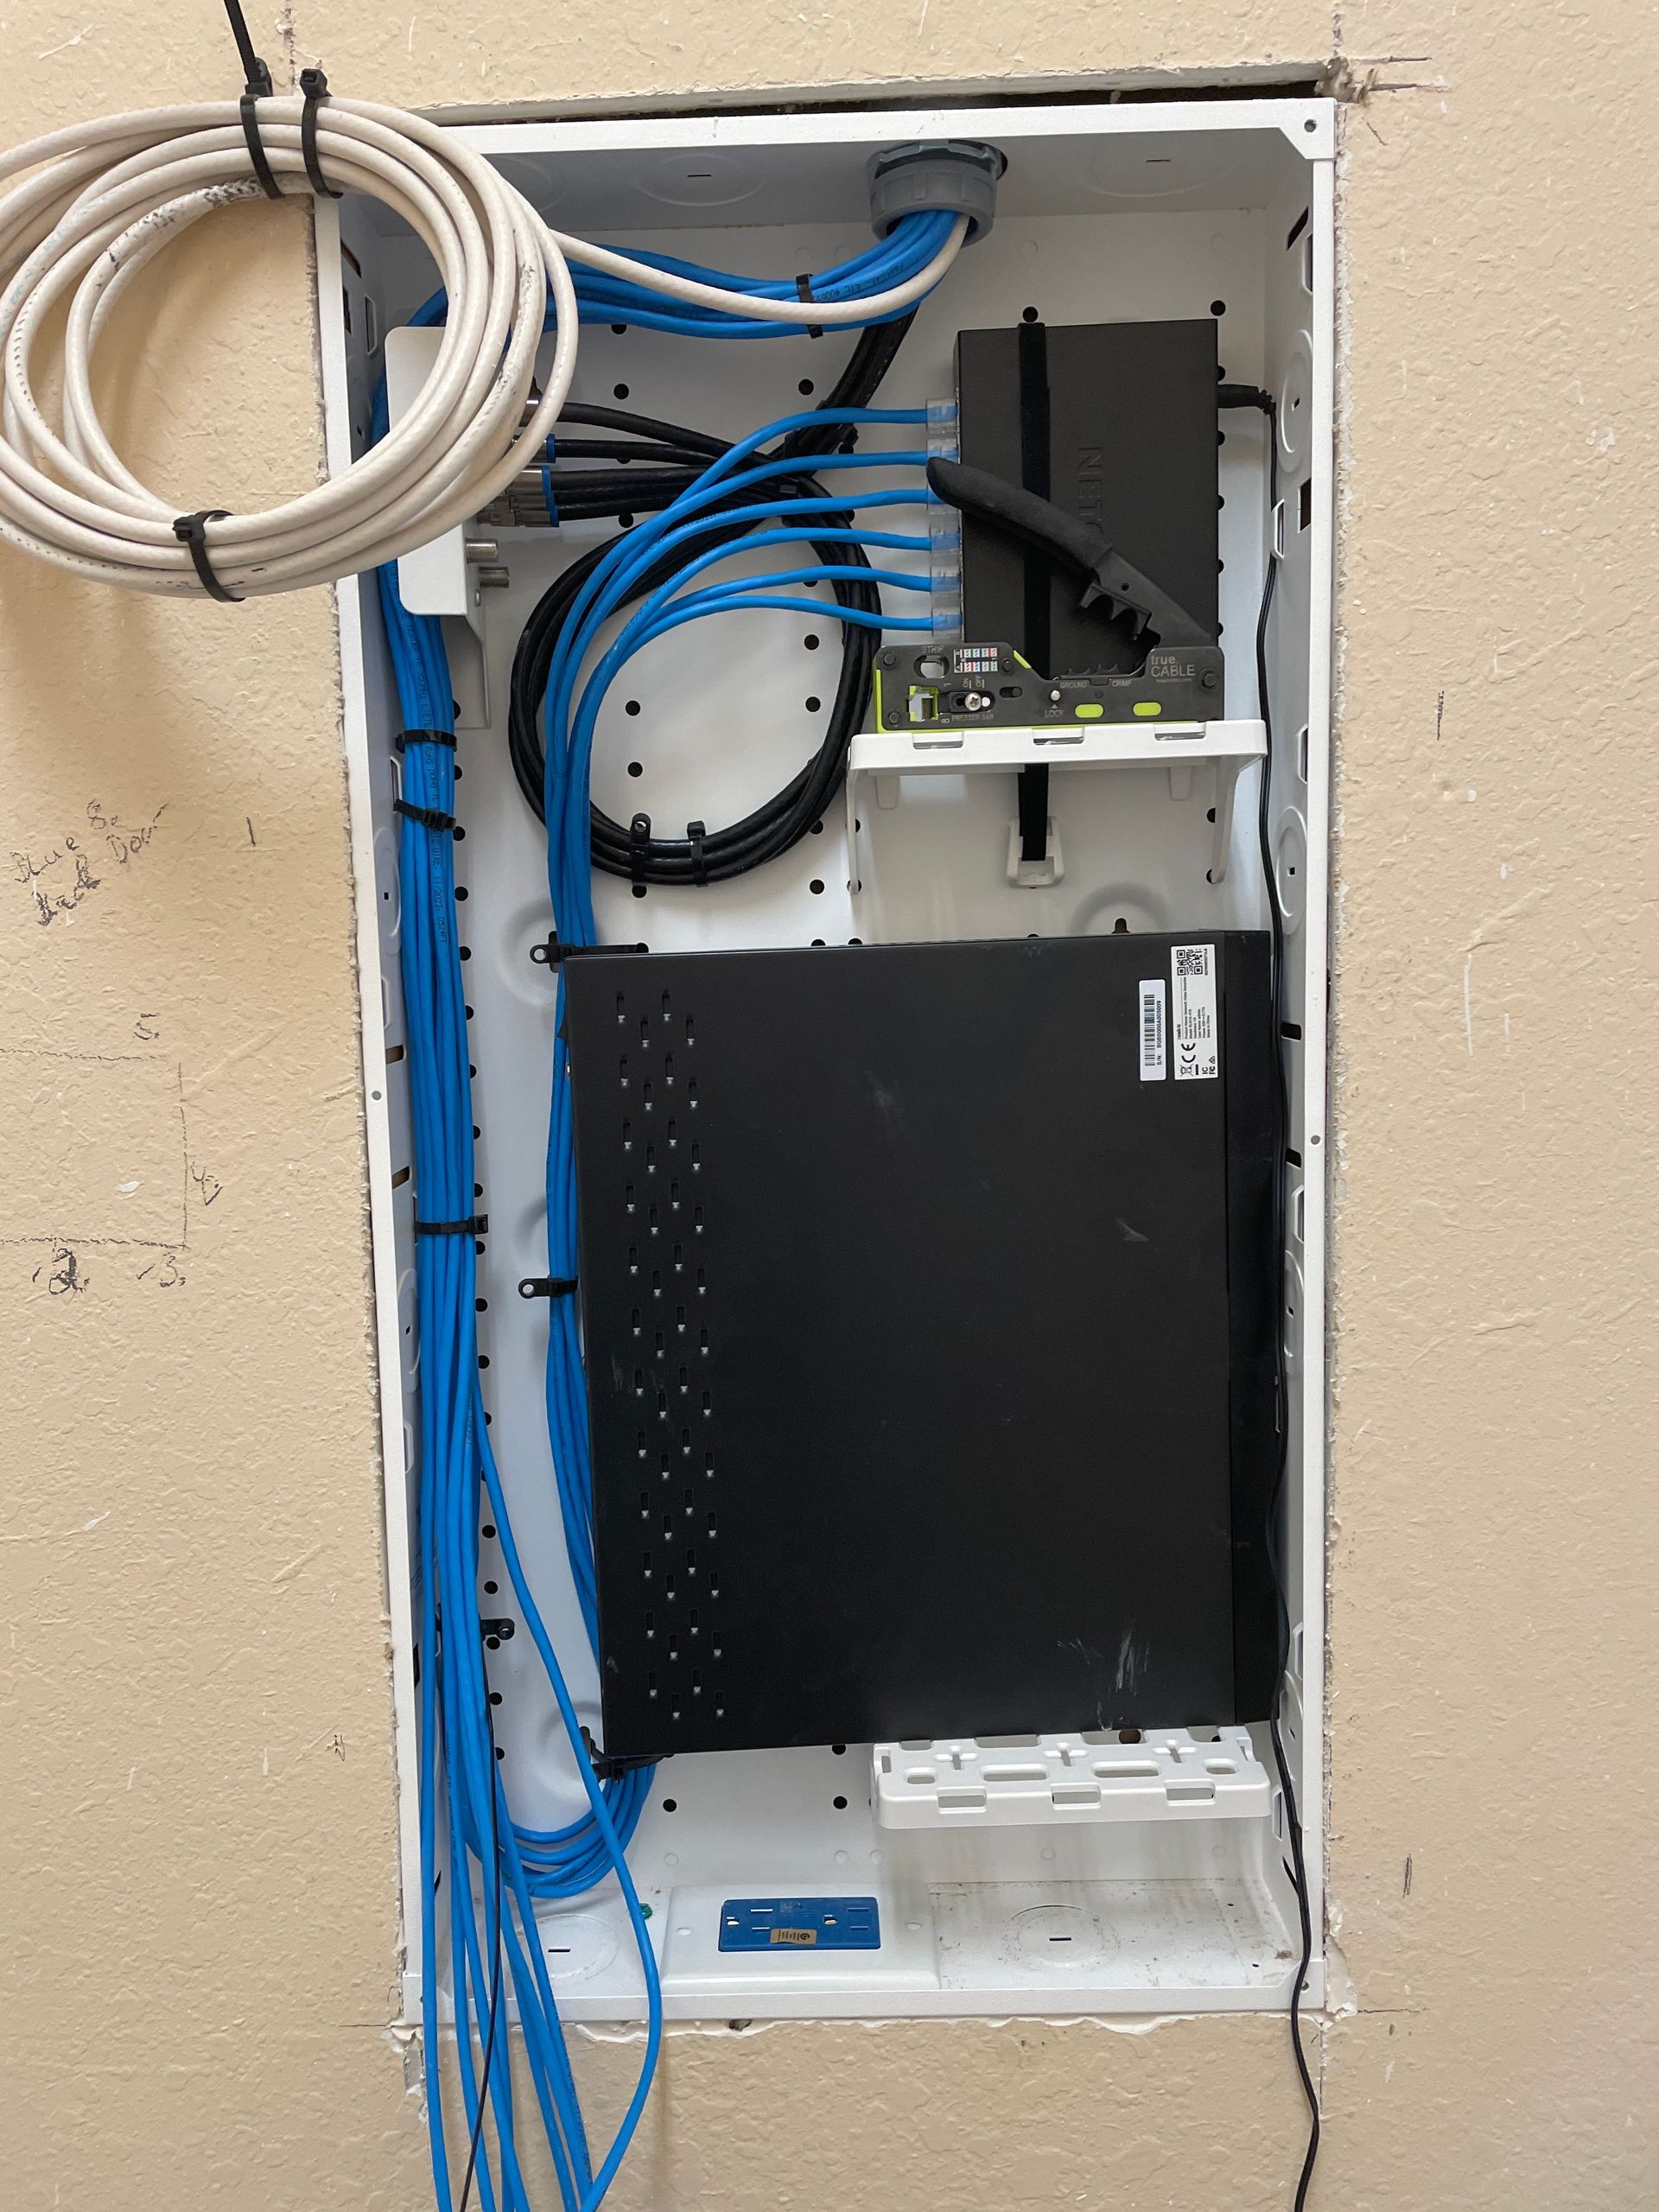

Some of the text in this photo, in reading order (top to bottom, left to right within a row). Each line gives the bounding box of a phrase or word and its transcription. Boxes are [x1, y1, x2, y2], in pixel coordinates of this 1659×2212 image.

[1151, 655, 1176, 664] true
[1151, 664, 1196, 677] CABLE
[1059, 681, 1088, 690] GROUND
[1112, 679, 1132, 688] CRIMP
[1044, 709, 1065, 718] LOCK
